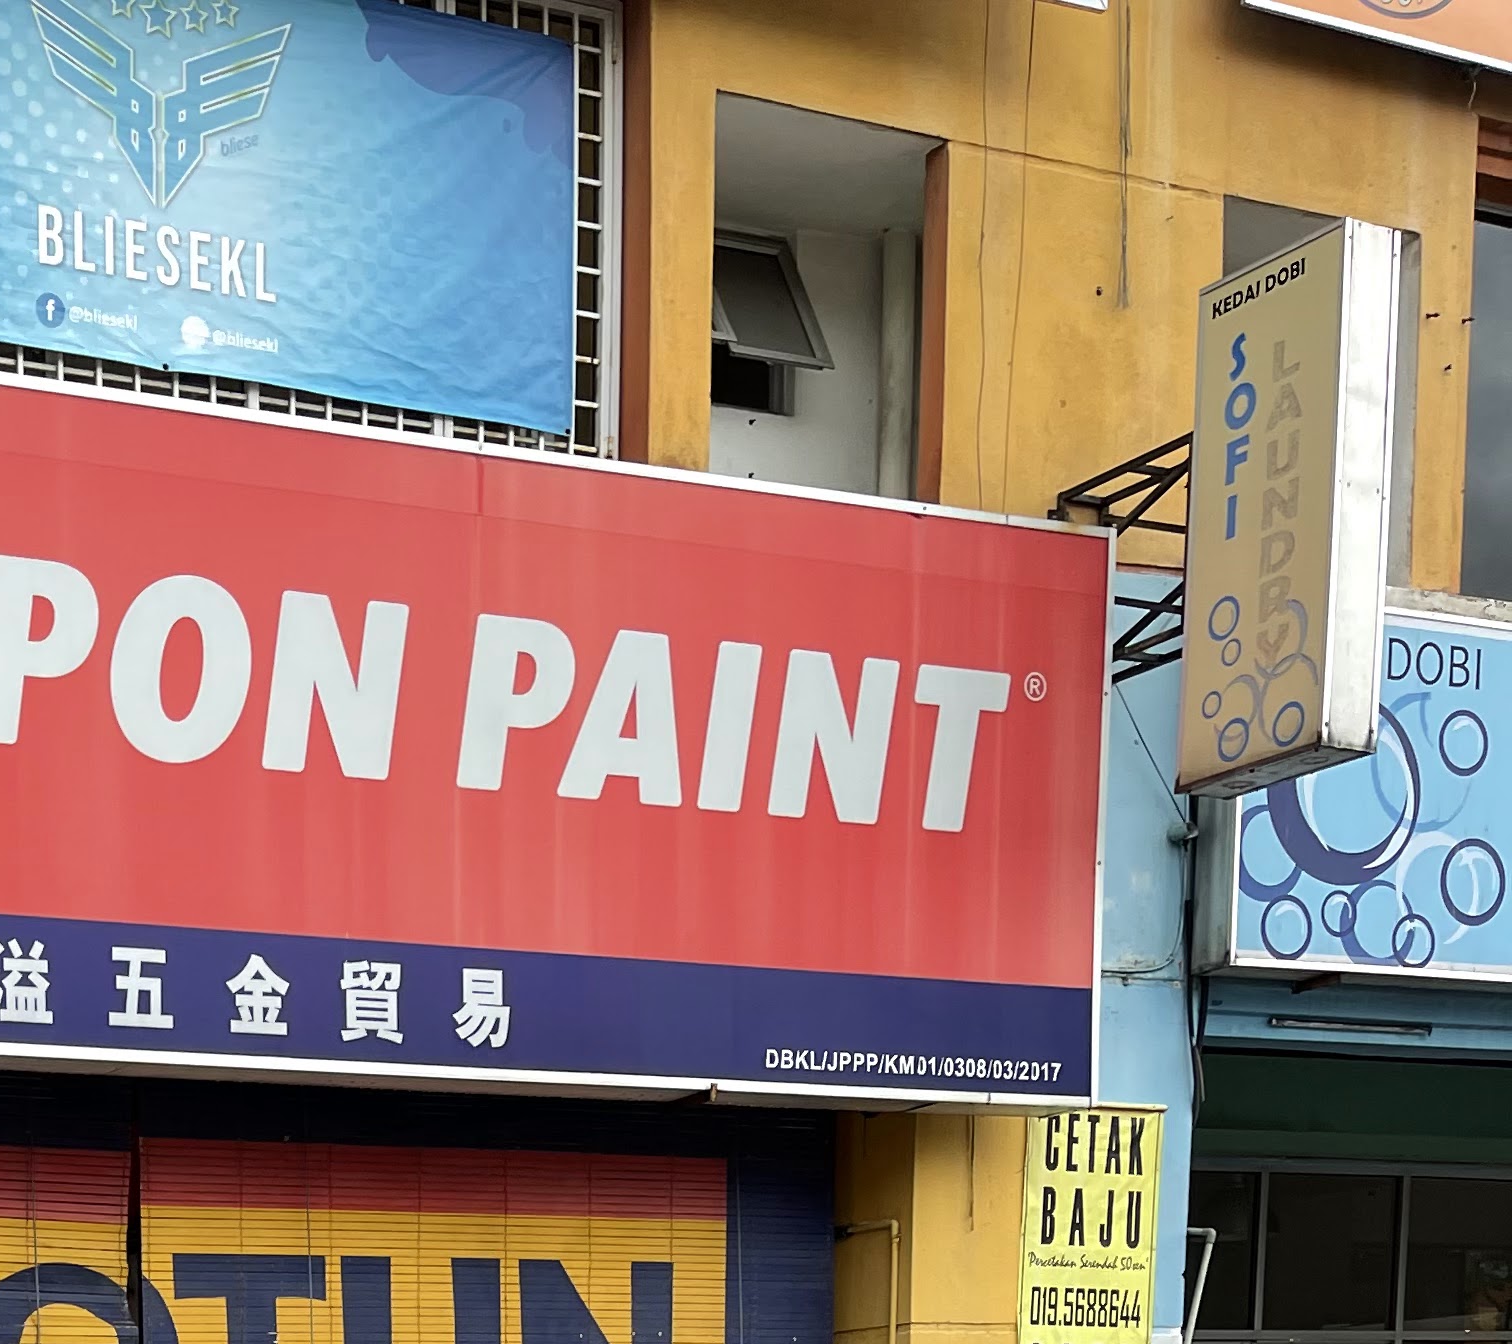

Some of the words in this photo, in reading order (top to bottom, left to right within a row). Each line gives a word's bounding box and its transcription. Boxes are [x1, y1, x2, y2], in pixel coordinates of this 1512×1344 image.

[38, 203, 277, 302] BLIESEKL
[1212, 281, 1261, 319] KEDAI
[1265, 257, 1306, 294] DOBI
[1224, 332, 1256, 541] SOFI
[1256, 340, 1303, 668] LAUNDRY
[1387, 637, 1482, 690] DOBI
[456, 613, 1011, 832] PAINT
[765, 1048, 1062, 1082] DBKL/JPPP/KM01/0308/03/2017
[1045, 1114, 1145, 1176] CETAK
[1041, 1186, 1142, 1249] BAJU
[1030, 1286, 1141, 1328] 019.5688644
